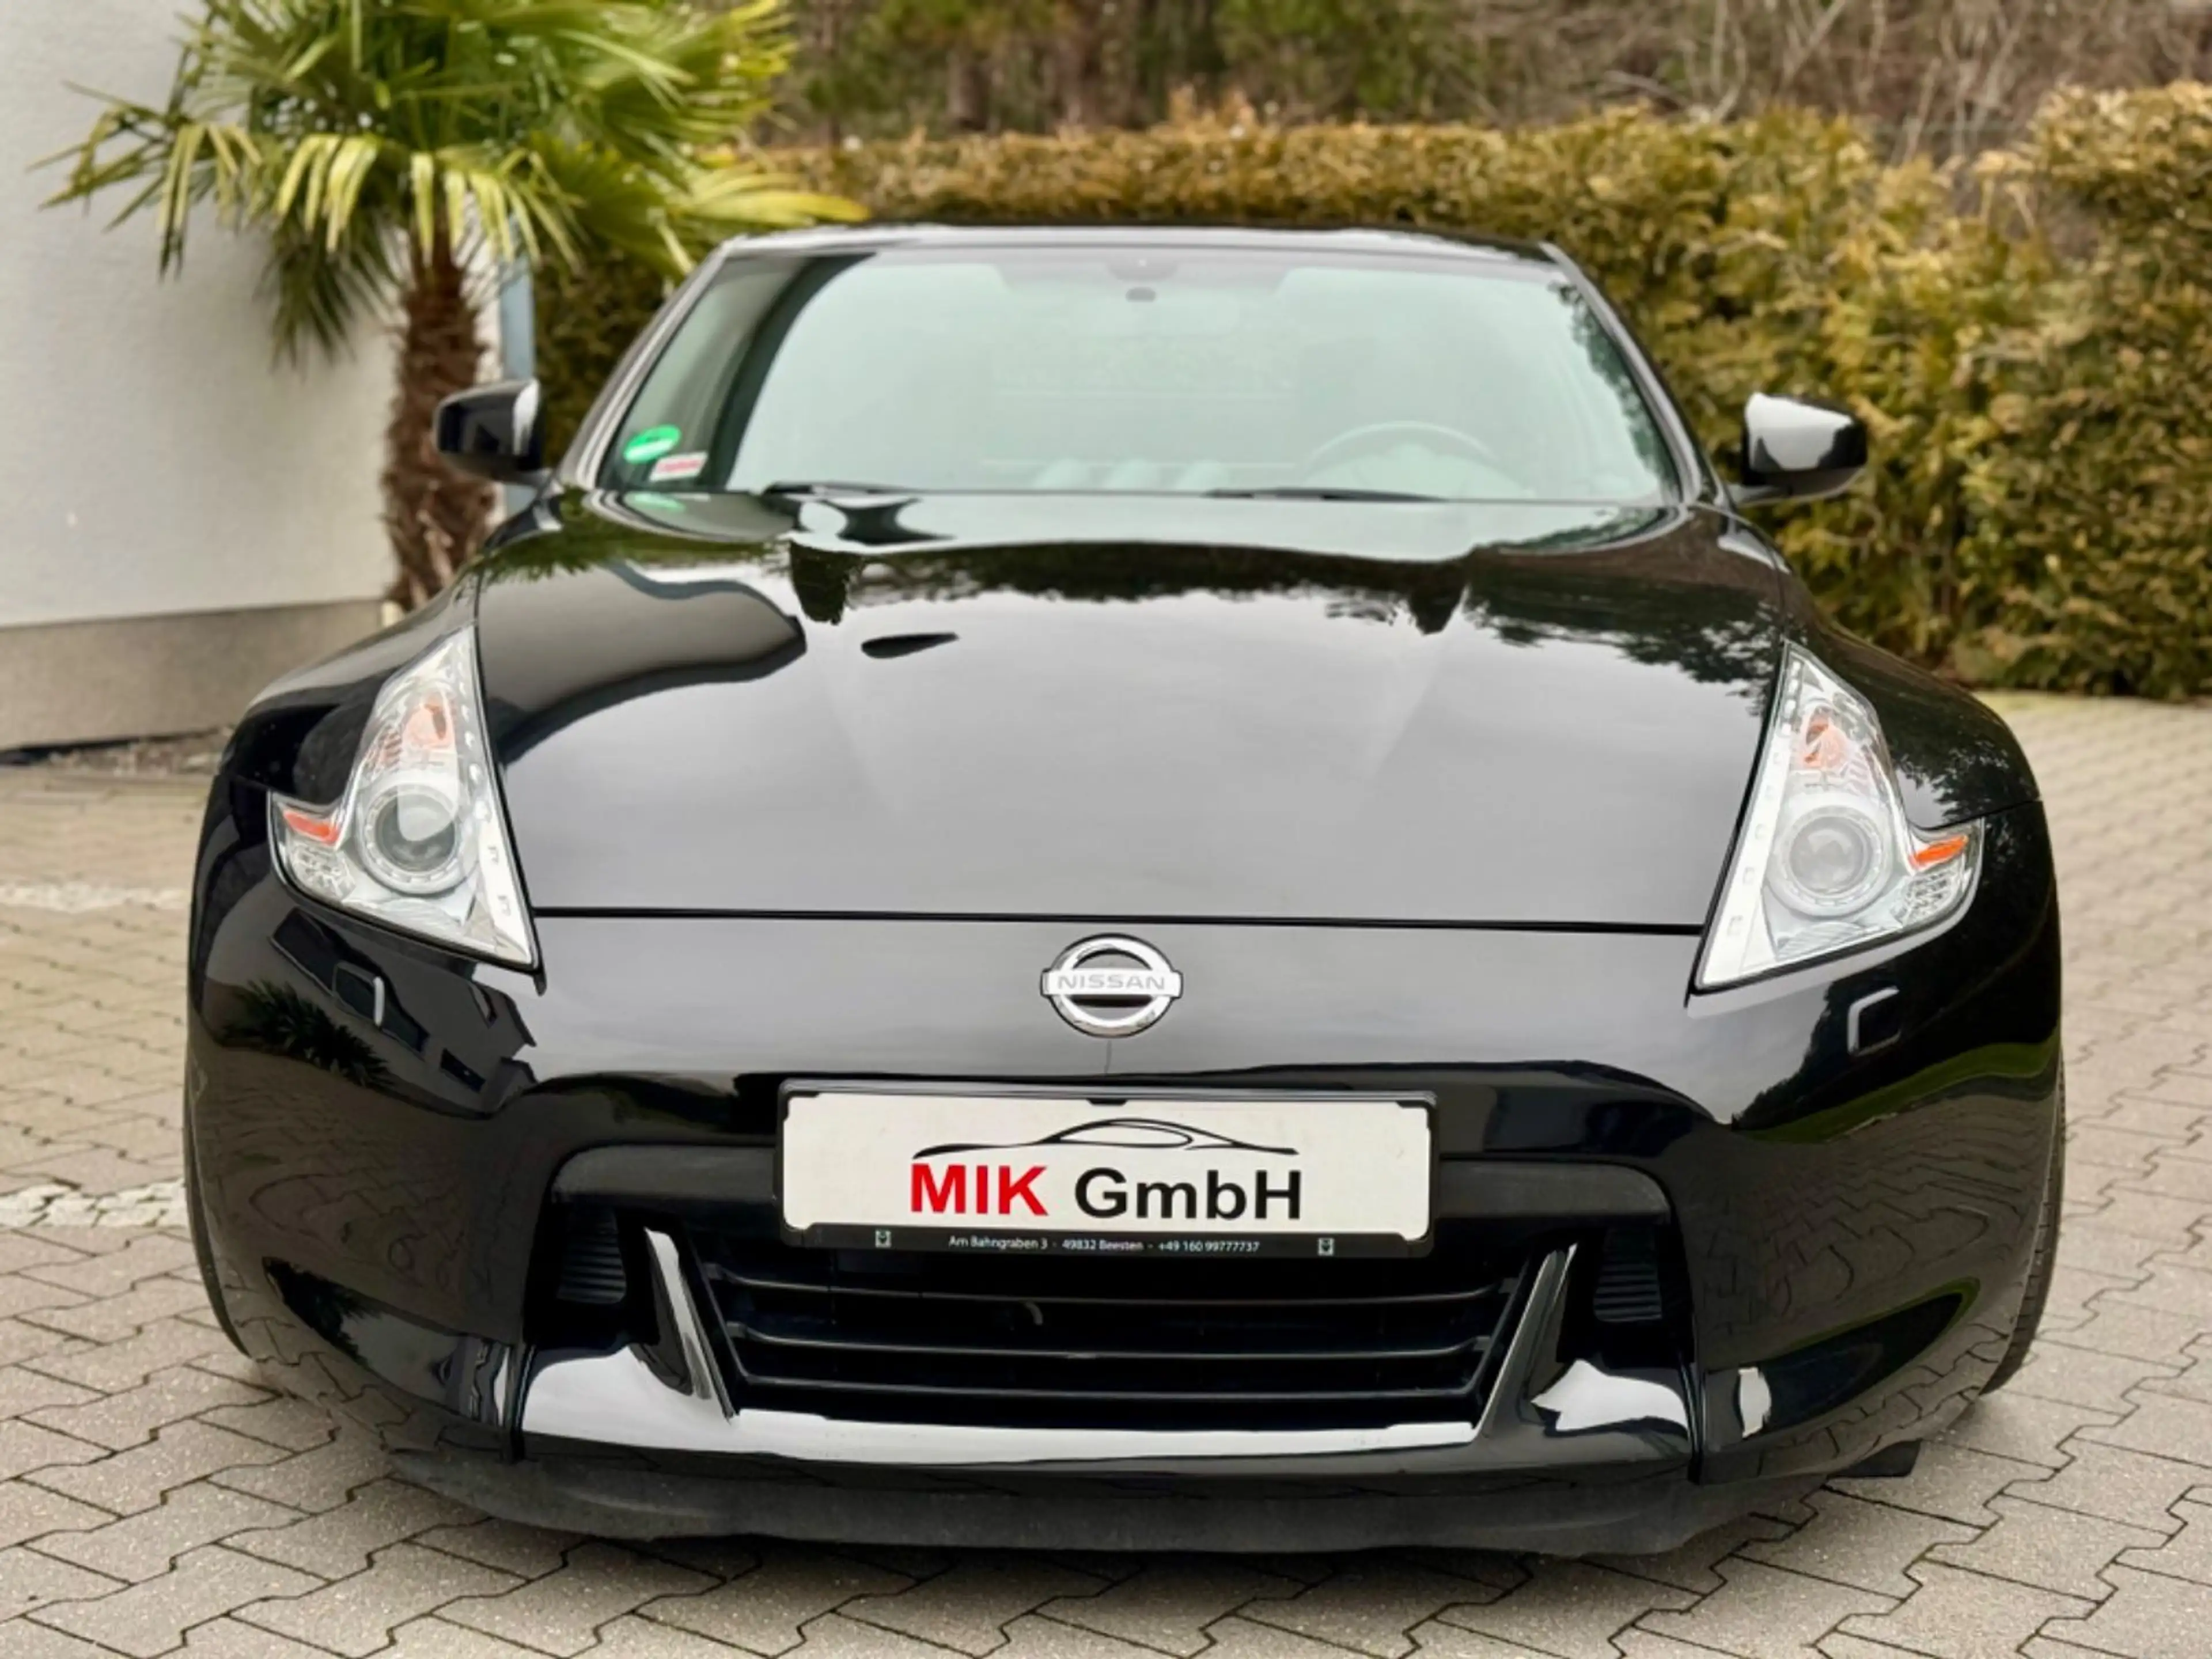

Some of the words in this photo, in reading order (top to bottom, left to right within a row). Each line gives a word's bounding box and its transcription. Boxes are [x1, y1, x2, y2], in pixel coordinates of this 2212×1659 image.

[1058, 974, 1165, 990] NISSAN
[910, 1162, 1048, 1217] MIK
[1075, 1166, 1301, 1220] GmbH
[949, 1236, 968, 1248] Am
[970, 1236, 1039, 1251] Bahngraben
[1040, 1237, 1048, 1250] 3
[1158, 1240, 1180, 1251] +49
[1182, 1240, 1203, 1252] 160
